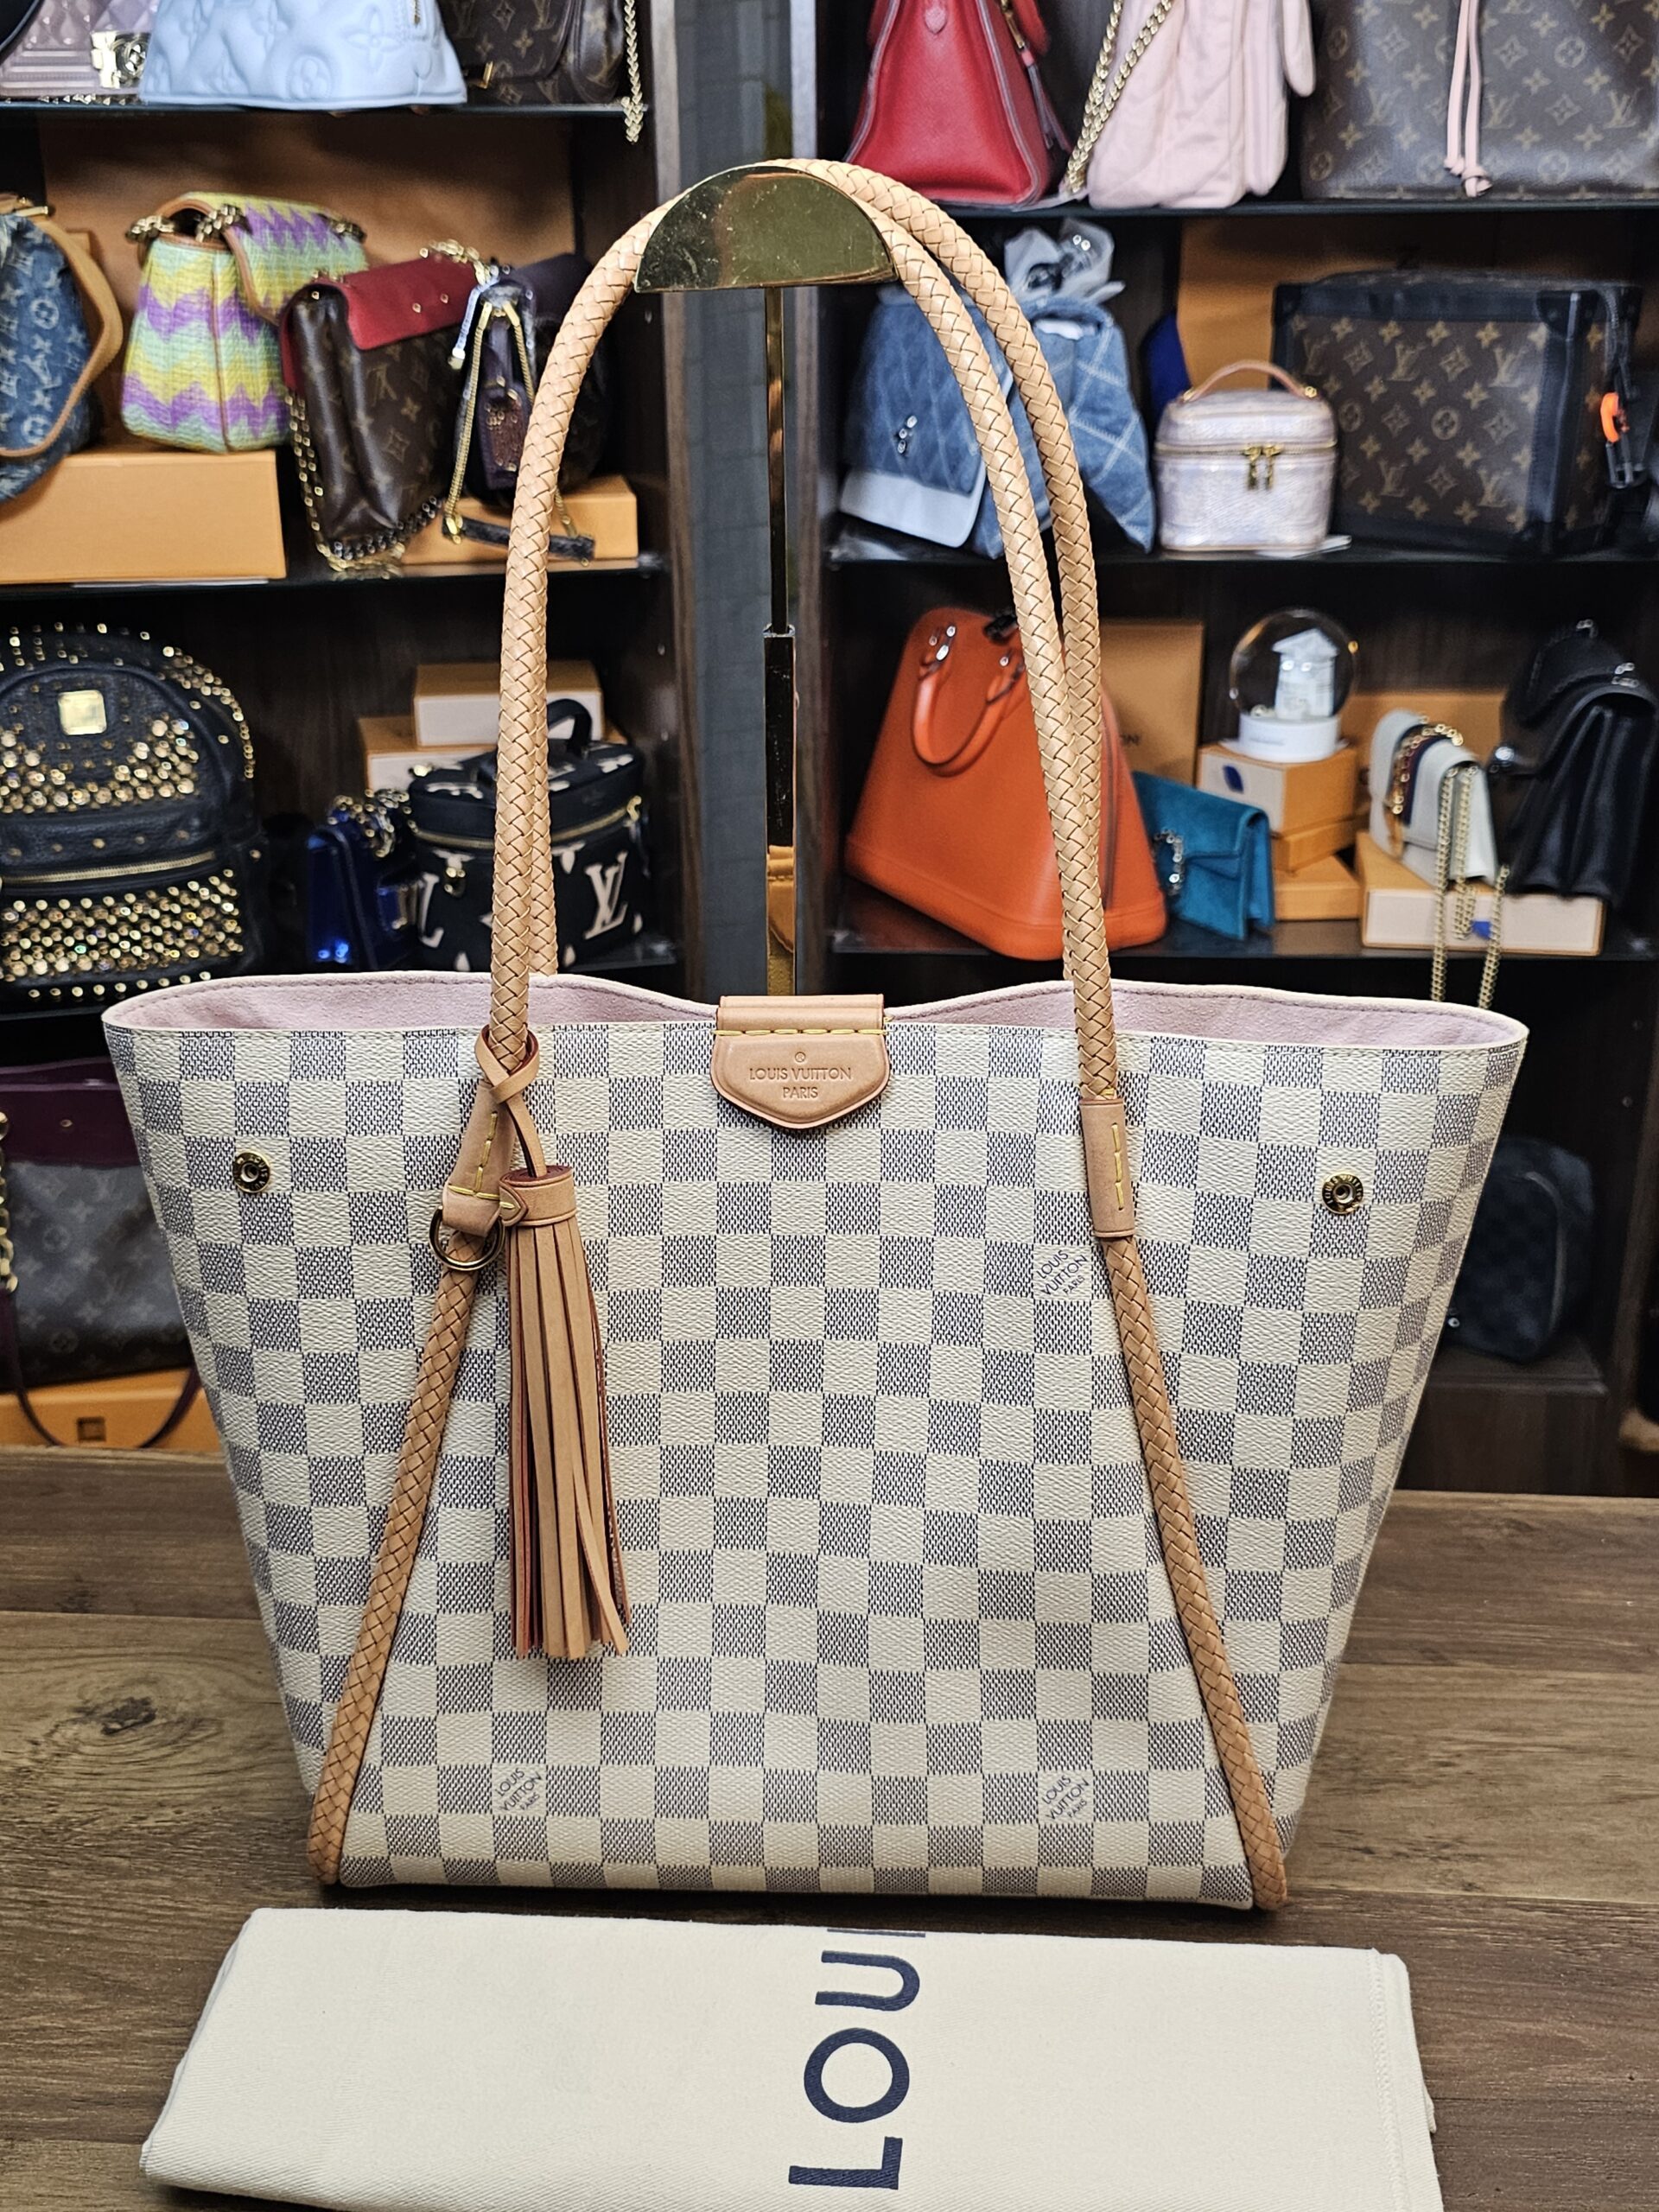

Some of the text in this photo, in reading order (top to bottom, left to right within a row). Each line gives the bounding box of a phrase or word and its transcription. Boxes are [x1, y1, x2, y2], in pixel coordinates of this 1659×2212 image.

[583, 850, 629, 940] LV
[749, 1067, 852, 1080] LOUIS VUITTON
[783, 1086, 818, 1099] PARIS
[1036, 1249, 1069, 1279] LOUIS
[1041, 1255, 1088, 1295] VUITTON
[495, 1768, 524, 1796] LOUIS
[500, 1771, 543, 1811] VUITTON
[1042, 1775, 1071, 1804] LOUIS
[1046, 1778, 1090, 1820] VUITTON
[788, 1928, 925, 2190] LOU
